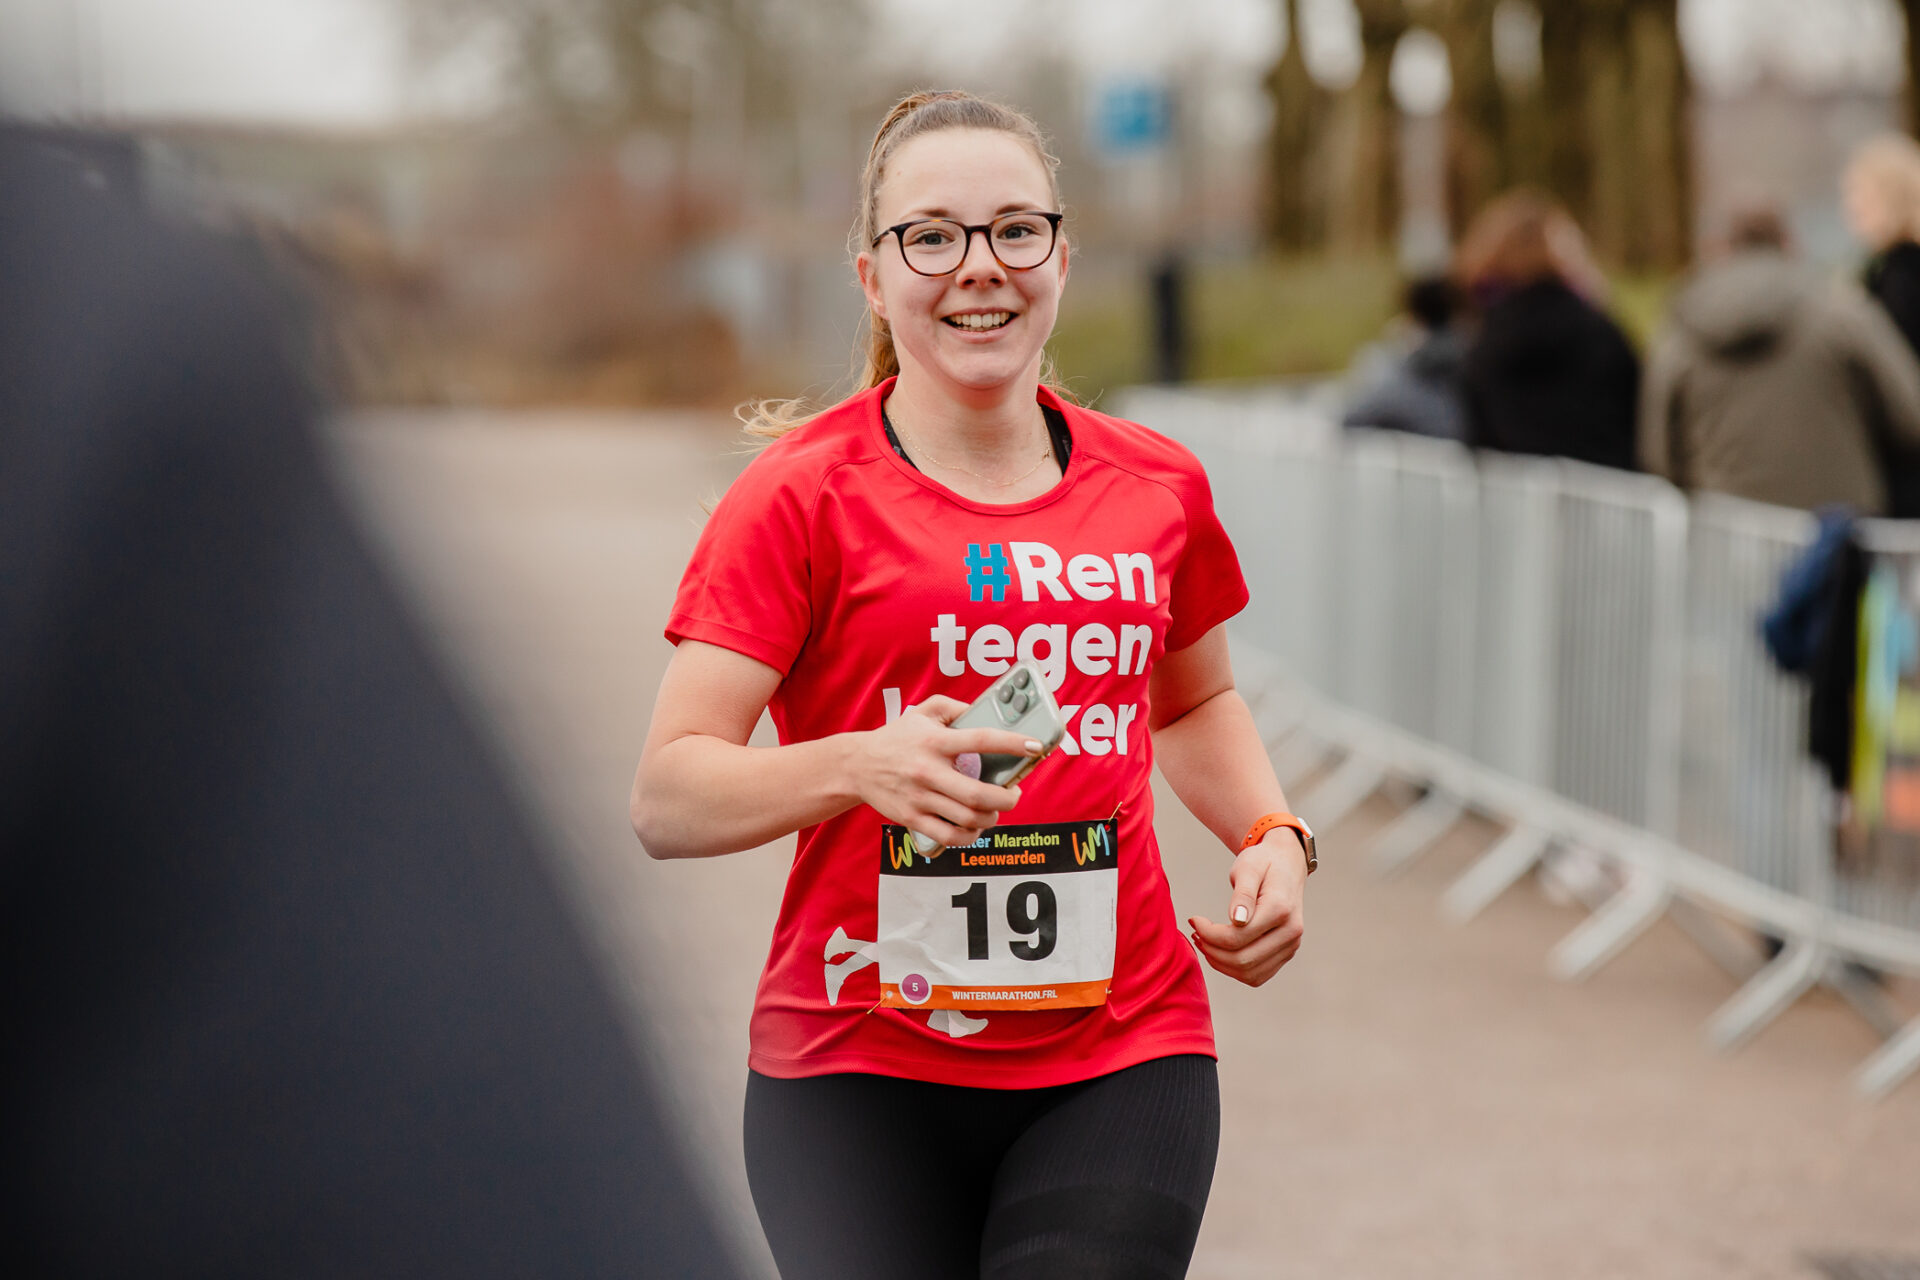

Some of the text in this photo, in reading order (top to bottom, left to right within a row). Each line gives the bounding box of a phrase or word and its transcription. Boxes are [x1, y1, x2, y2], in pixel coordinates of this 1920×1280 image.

[963, 541, 1157, 605] #Ren
[930, 613, 1154, 693] tegen
[994, 832, 1060, 849] Marathon
[960, 850, 1046, 867] Leeuwarden
[951, 880, 1058, 961] 19
[911, 982, 919, 992] 5
[951, 989, 1058, 1000] WINTERMARATHON.FRL
